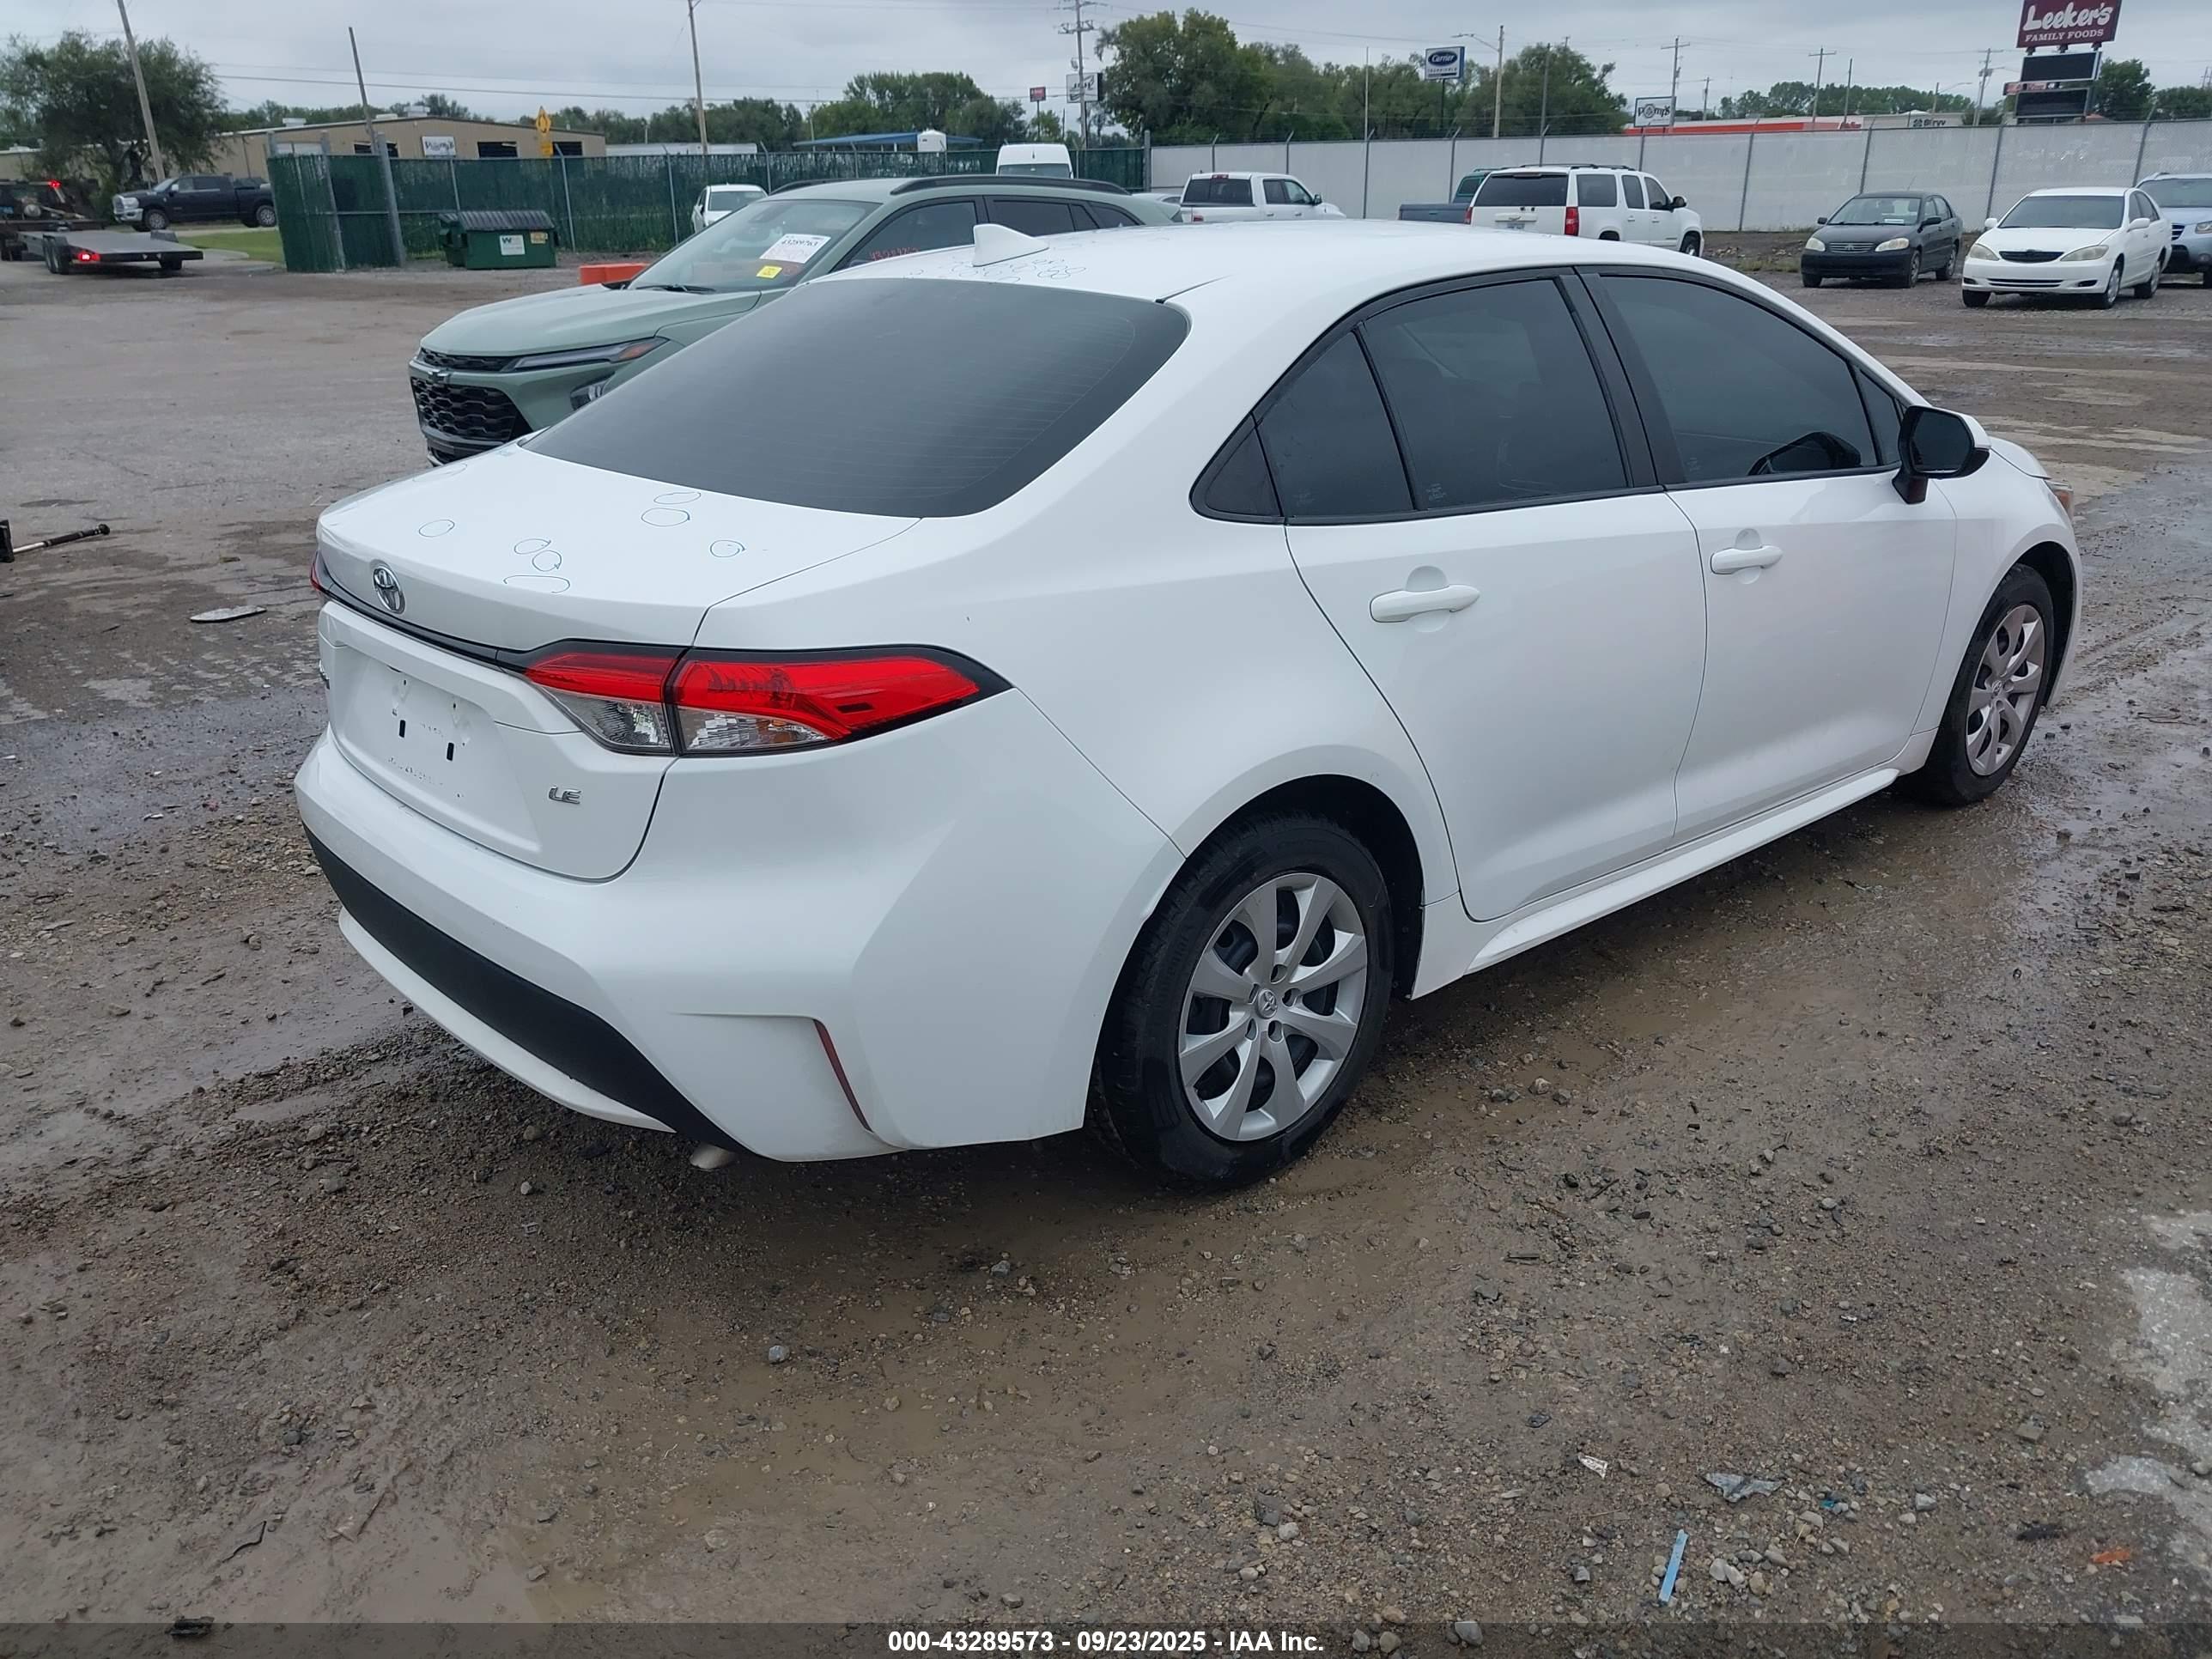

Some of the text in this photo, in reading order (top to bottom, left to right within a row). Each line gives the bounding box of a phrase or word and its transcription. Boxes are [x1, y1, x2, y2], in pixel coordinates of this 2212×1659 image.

[2022, 2, 2113, 31] Leeker's
[2025, 28, 2104, 42] FAMILY FOODS
[1431, 54, 1455, 63] Carrier
[549, 786, 581, 804] LE
